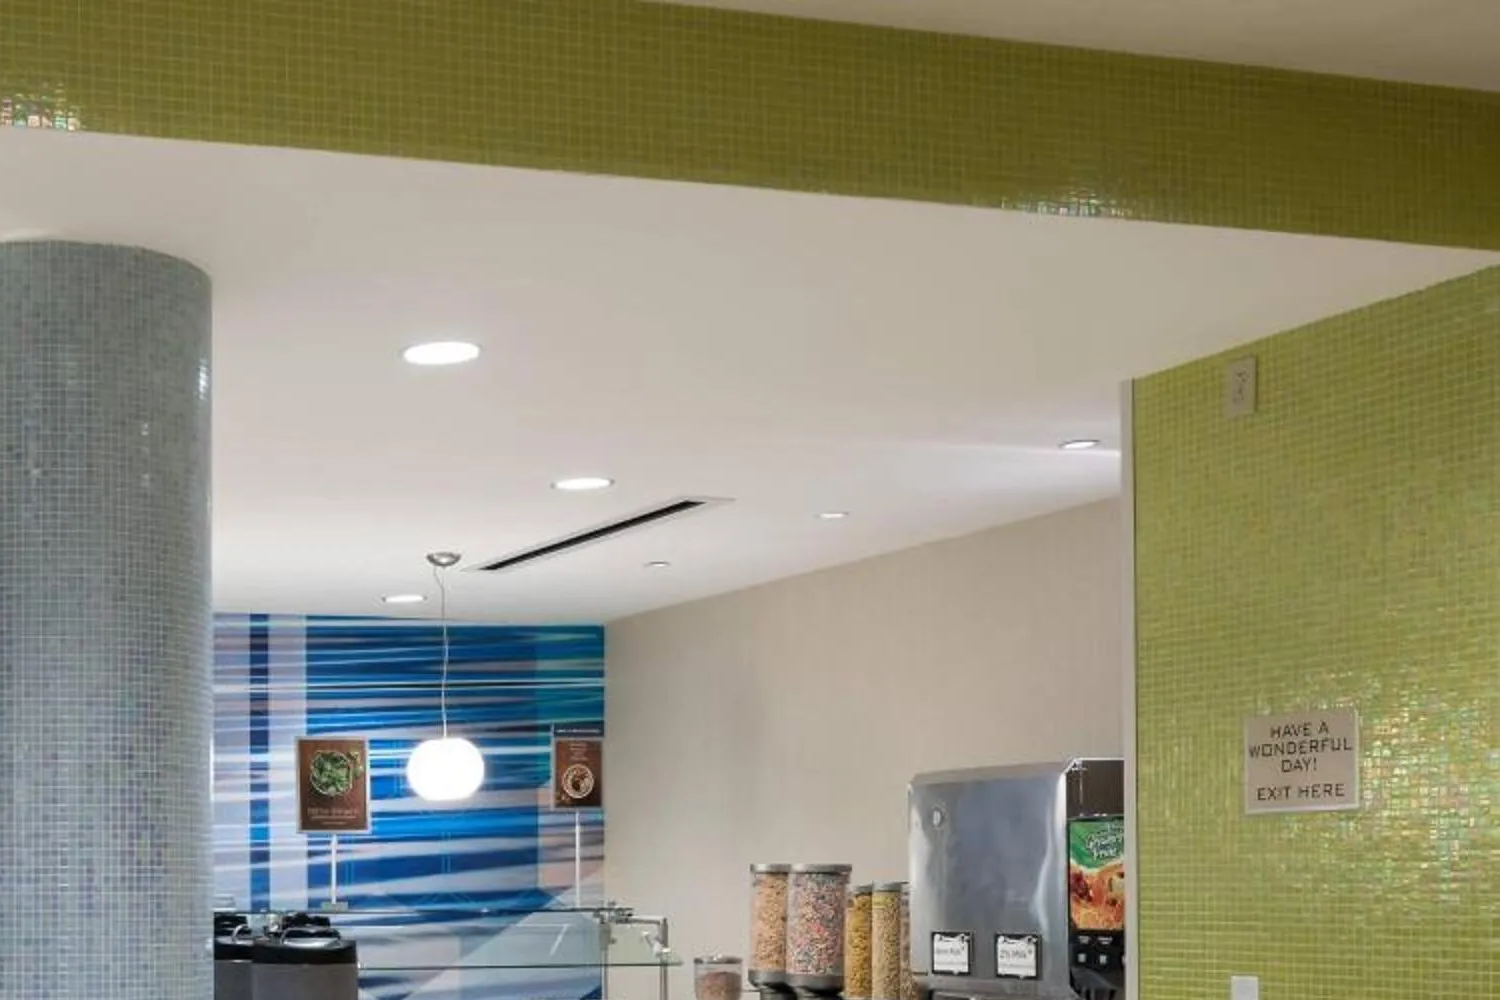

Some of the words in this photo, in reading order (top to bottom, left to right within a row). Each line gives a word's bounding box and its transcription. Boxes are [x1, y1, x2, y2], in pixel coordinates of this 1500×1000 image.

[1270, 721, 1313, 739] HAVE
[1318, 720, 1329, 734] A
[1249, 737, 1353, 758] WONDERFUL
[1281, 758, 1317, 773] DAY!
[1257, 785, 1292, 801] EXIT
[1298, 783, 1345, 799] HERE
